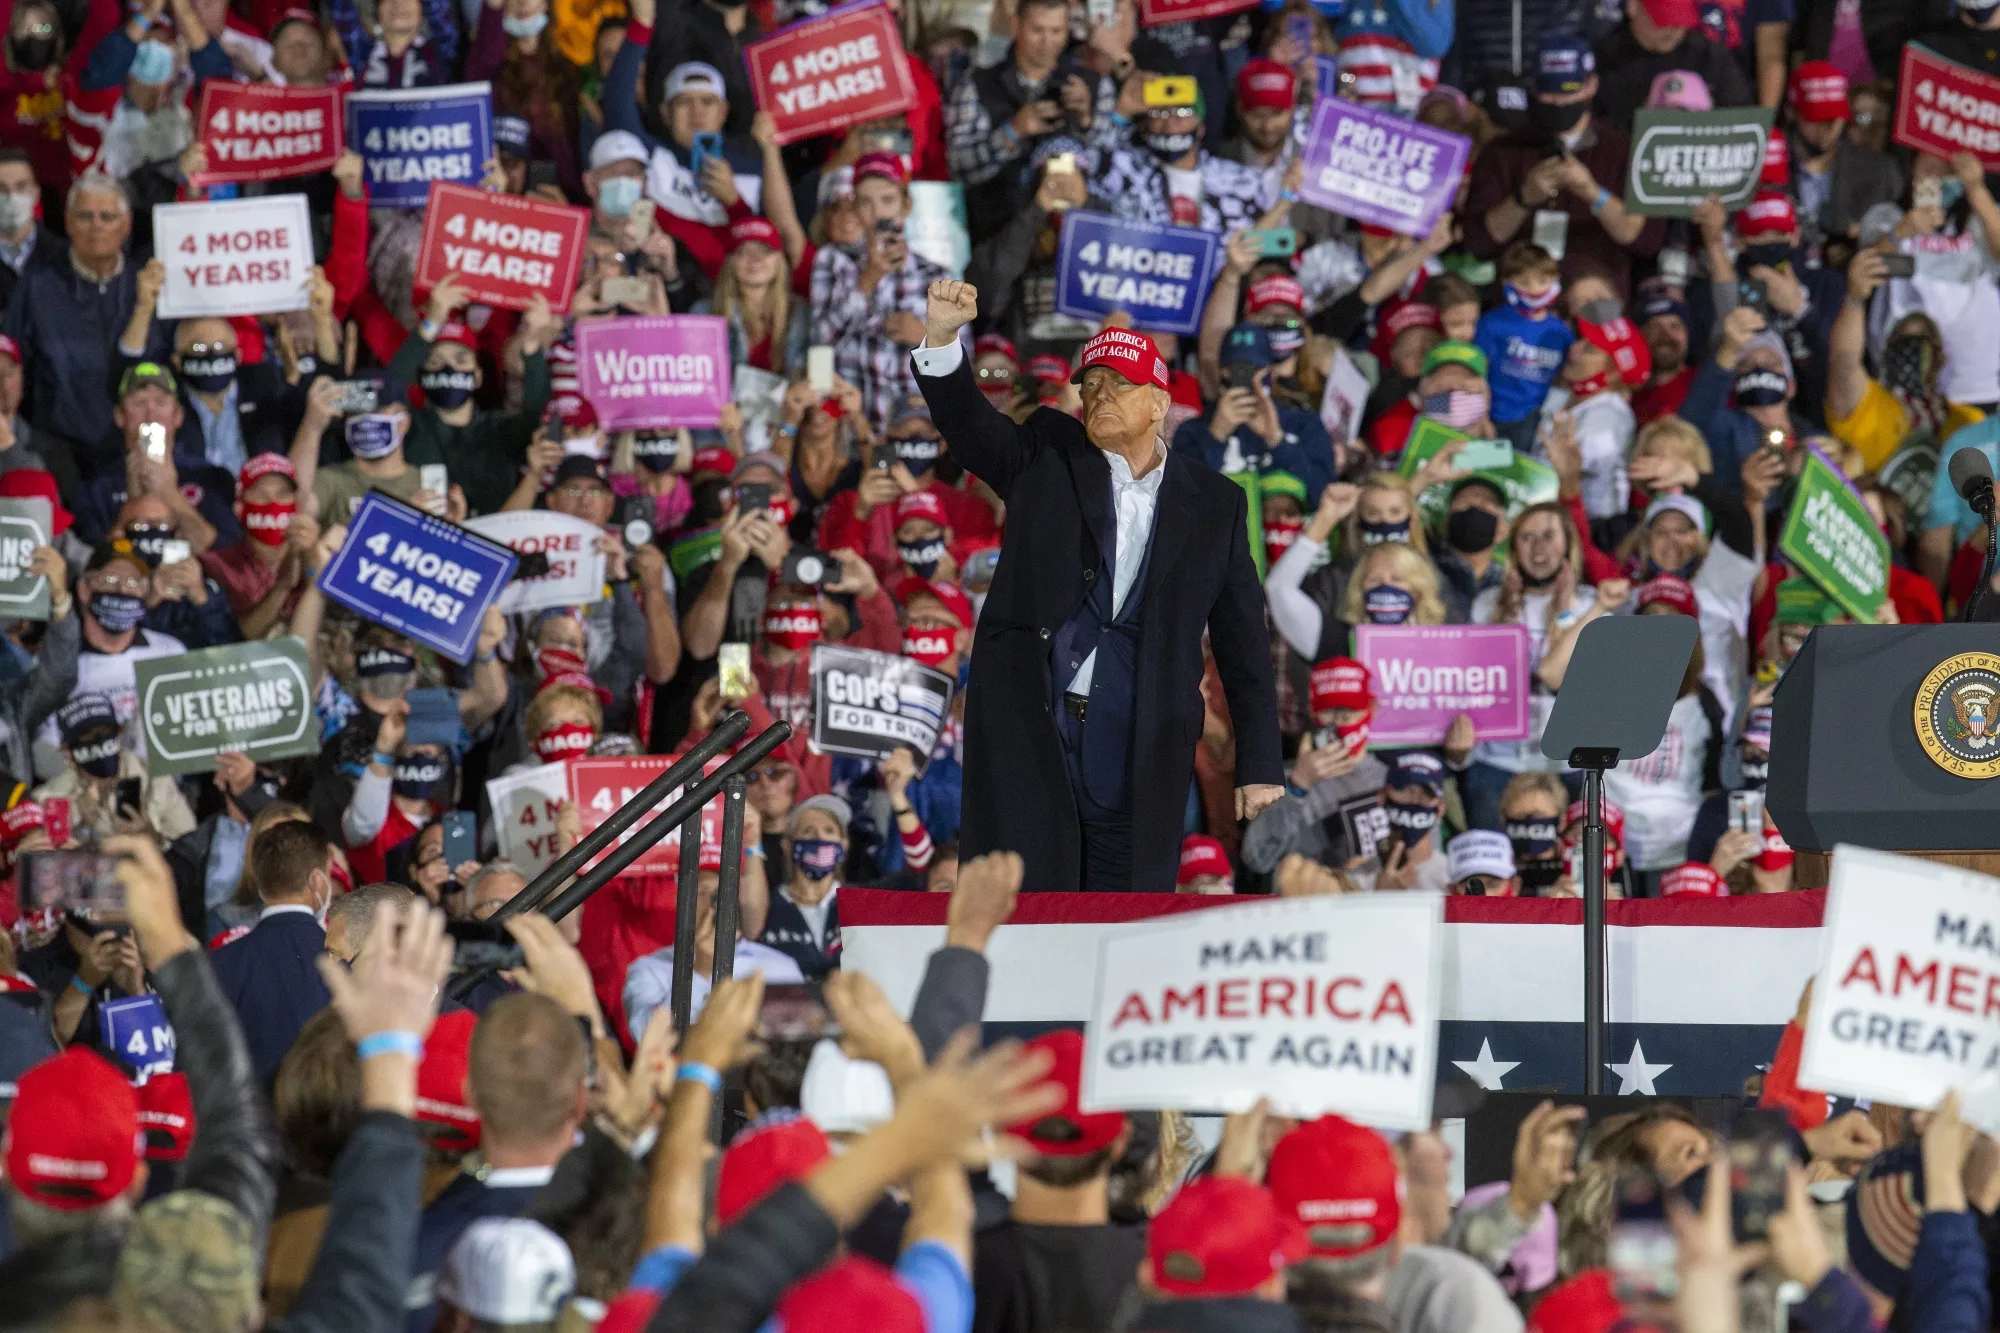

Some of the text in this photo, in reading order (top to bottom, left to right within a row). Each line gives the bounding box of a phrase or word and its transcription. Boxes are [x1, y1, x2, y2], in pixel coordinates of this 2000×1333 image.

[769, 33, 880, 86] 4 MORE
[775, 64, 887, 115] YEARS!
[1914, 80, 2000, 127] 4 MOR
[210, 107, 324, 133] 4 MORE
[364, 126, 383, 152] 4
[386, 122, 473, 151] MORE
[211, 133, 322, 161] YEARS!
[1654, 142, 1757, 172] VETERANS
[367, 152, 473, 183] YEARS!
[179, 228, 291, 254] 4 MORE
[443, 213, 563, 258] 4 MORE
[183, 260, 292, 288] YEARS!
[442, 243, 554, 287] YEARS!
[1079, 240, 1196, 281] 4 MORE
[1078, 270, 1187, 309] YEARS!
[1084, 331, 1147, 354] MAKE AMERICA
[1084, 345, 1140, 365] GREAT AGAIN
[594, 349, 714, 384] Women
[610, 382, 705, 398] FOR TRUMP
[246, 513, 292, 533] MAG
[366, 532, 392, 557] 4
[391, 546, 483, 598] MORE
[356, 557, 466, 626] YEARS!
[826, 669, 900, 714] COPS
[1376, 658, 1507, 695] Women
[164, 678, 294, 724] VETERANS
[833, 709, 875, 728] FOR
[1393, 695, 1496, 710] FOR TRUMP
[1918, 656, 1990, 772] SEAL OF THE PRESIDENT OF
[182, 708, 283, 738] FOR TRUMP
[519, 803, 537, 826] 4
[591, 786, 615, 813] 4
[1199, 931, 1329, 969] MAKE
[1934, 909, 2000, 956] MA
[1110, 976, 1414, 1031] AMERICA
[126, 1028, 149, 1056] 4
[1830, 1005, 1977, 1065] GREAT
[1105, 1031, 1416, 1078] GREAT AGAIN
